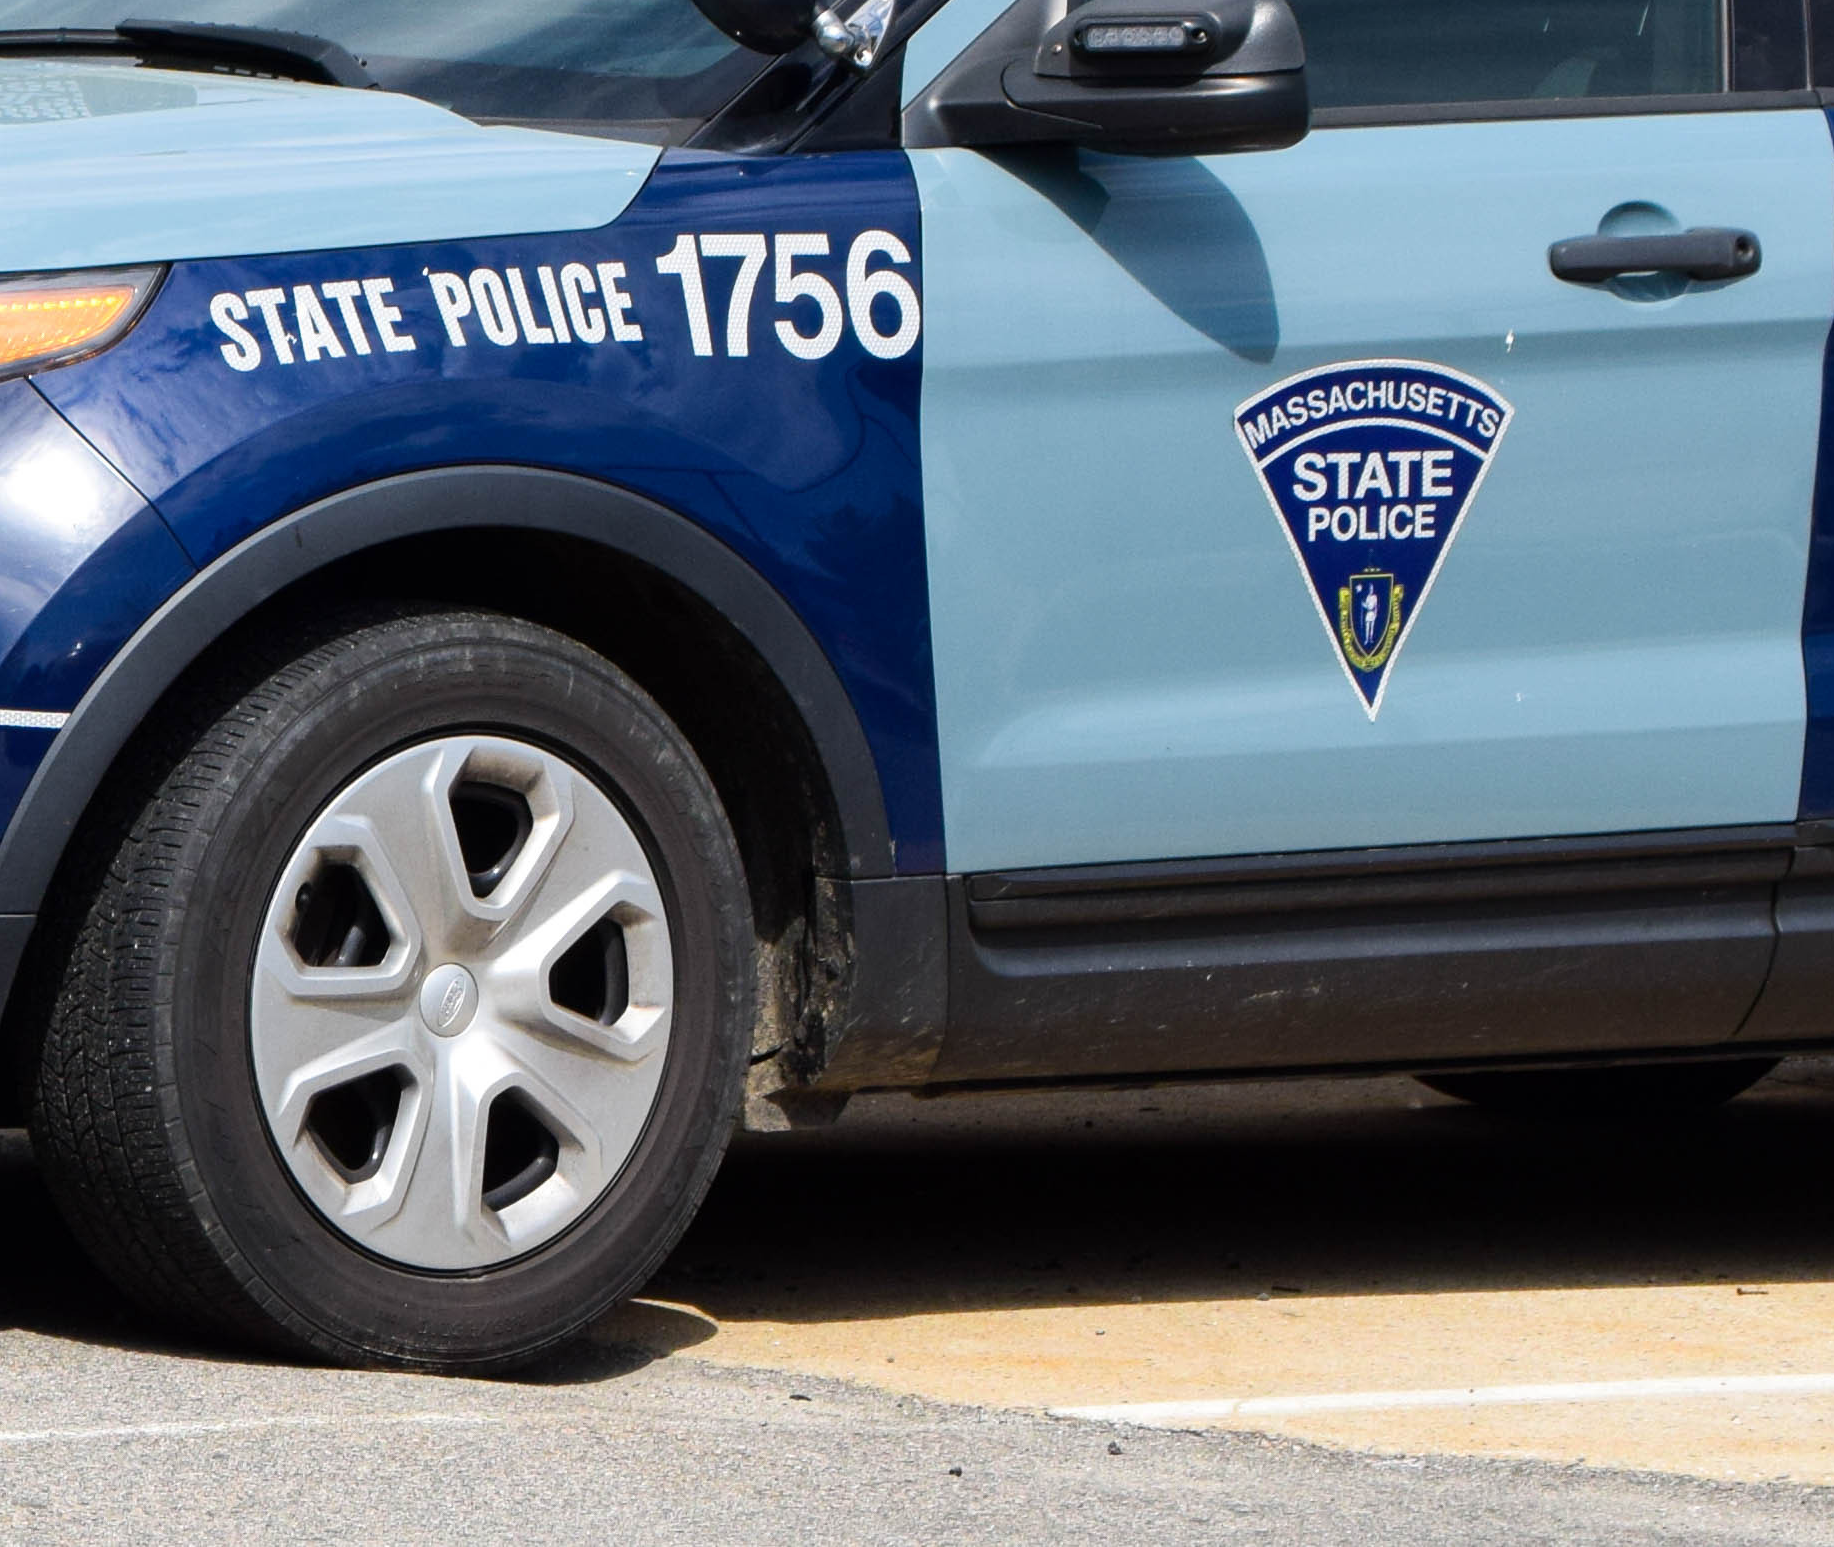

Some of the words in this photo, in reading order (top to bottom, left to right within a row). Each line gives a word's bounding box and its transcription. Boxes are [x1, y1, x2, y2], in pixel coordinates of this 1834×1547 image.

[209, 277, 417, 372] STATE
[423, 262, 644, 347] POLICE
[655, 229, 920, 360] 1756
[1242, 380, 1501, 449] MASSACHUSETTS
[1292, 450, 1454, 501] STATE
[1307, 504, 1436, 542] POLICE
